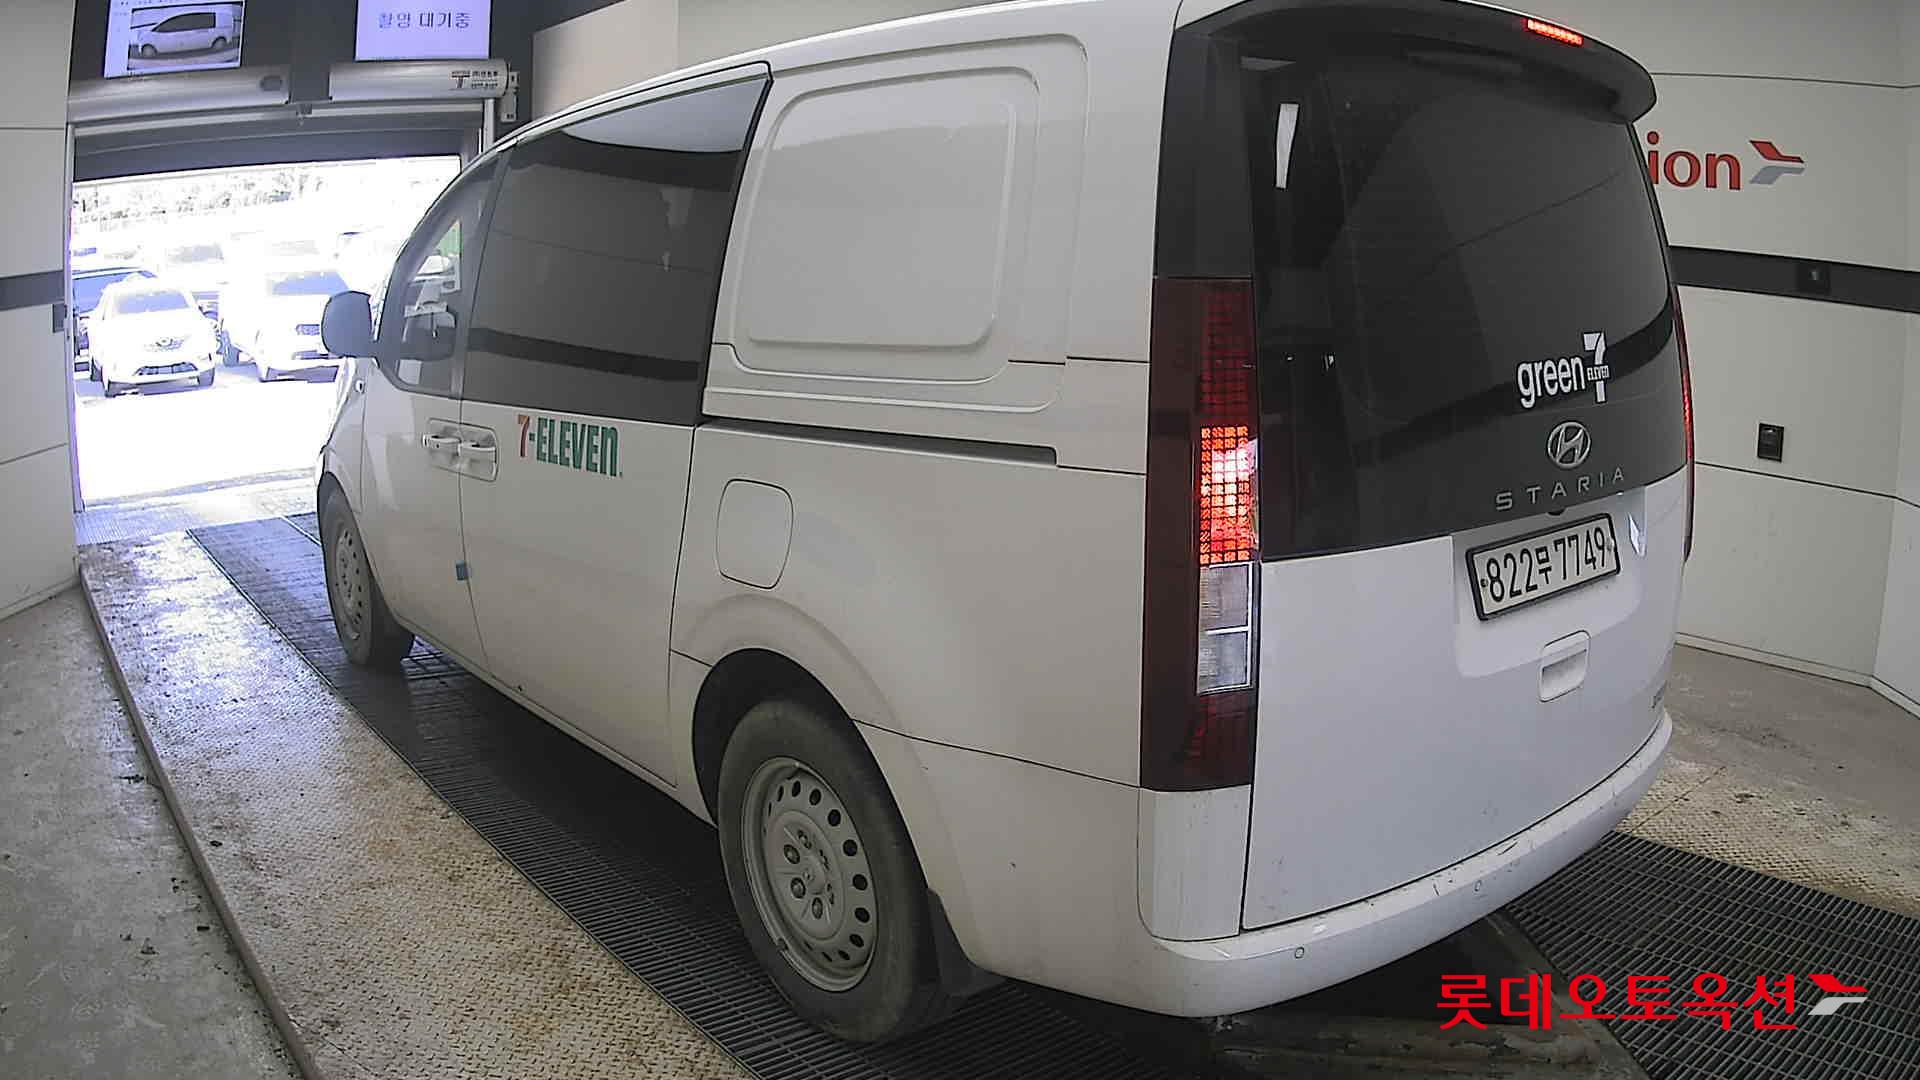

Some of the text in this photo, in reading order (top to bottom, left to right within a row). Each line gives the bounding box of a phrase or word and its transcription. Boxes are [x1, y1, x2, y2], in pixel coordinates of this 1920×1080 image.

[419, 11, 472, 29] 대기중
[1518, 357, 1586, 408] green
[1496, 467, 1624, 510] STARIA
[1486, 527, 1606, 602] 822무7749
